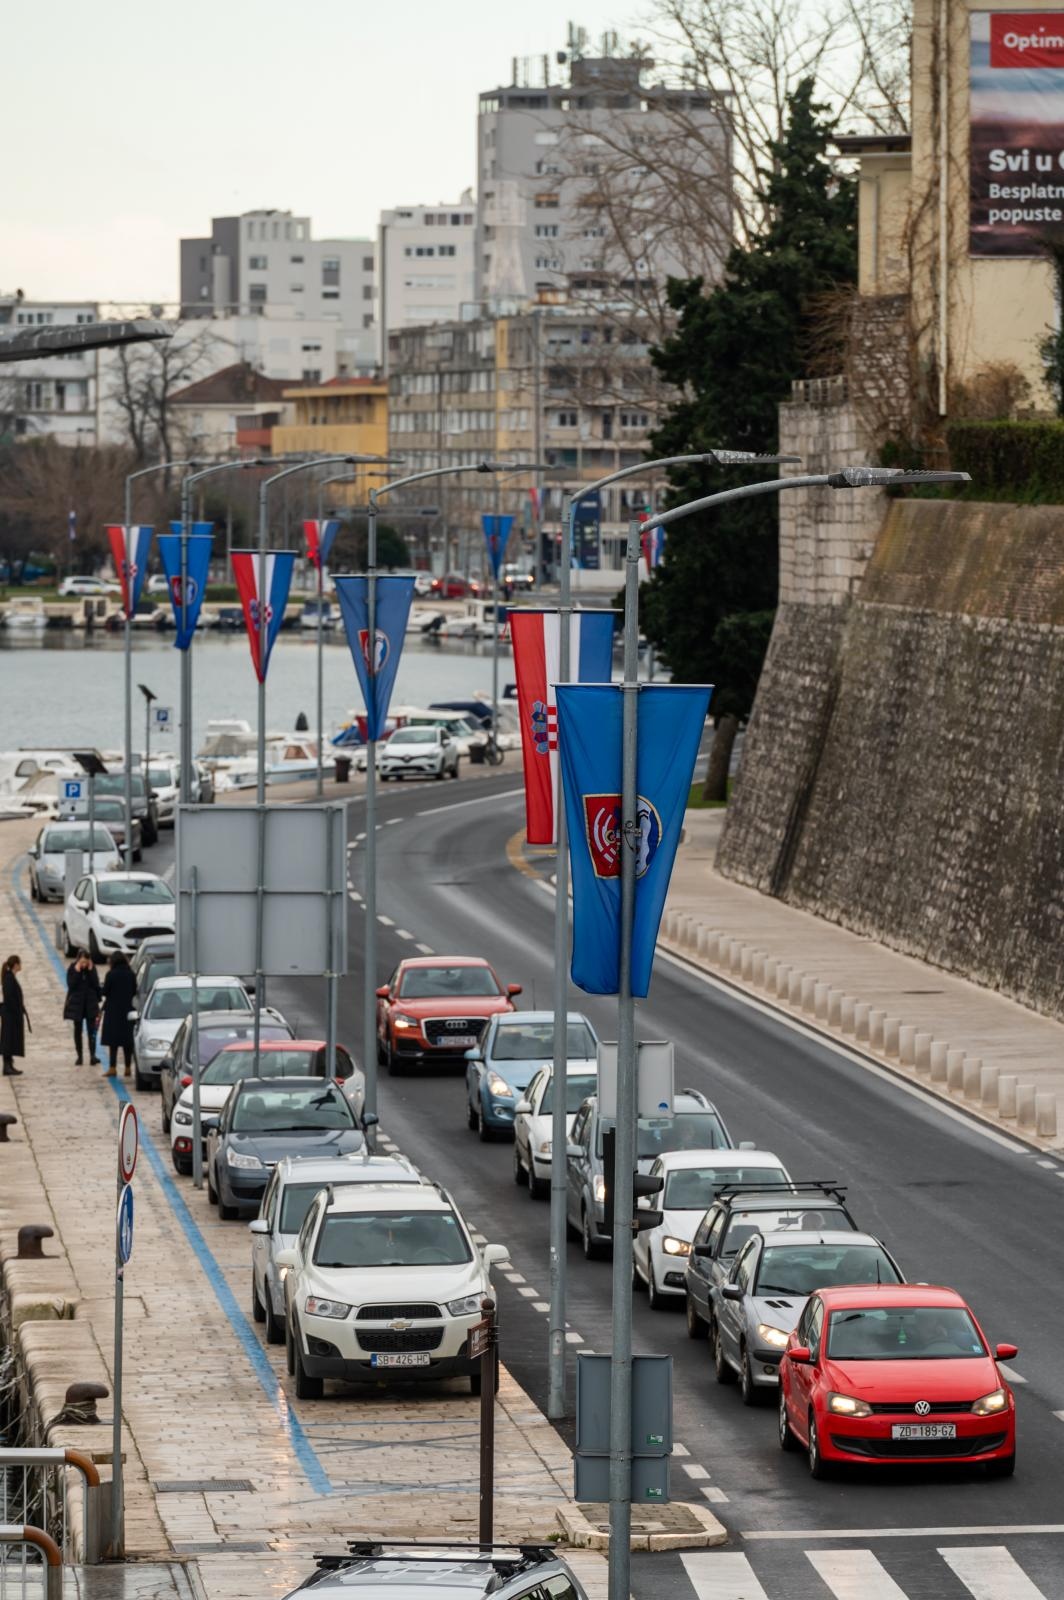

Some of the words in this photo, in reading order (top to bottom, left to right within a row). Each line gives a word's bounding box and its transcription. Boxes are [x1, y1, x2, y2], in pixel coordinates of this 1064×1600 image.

[1003, 26, 1064, 52] Optim
[988, 149, 1030, 172] Svi
[1035, 155, 1052, 172] u
[989, 206, 1062, 225] popuste
